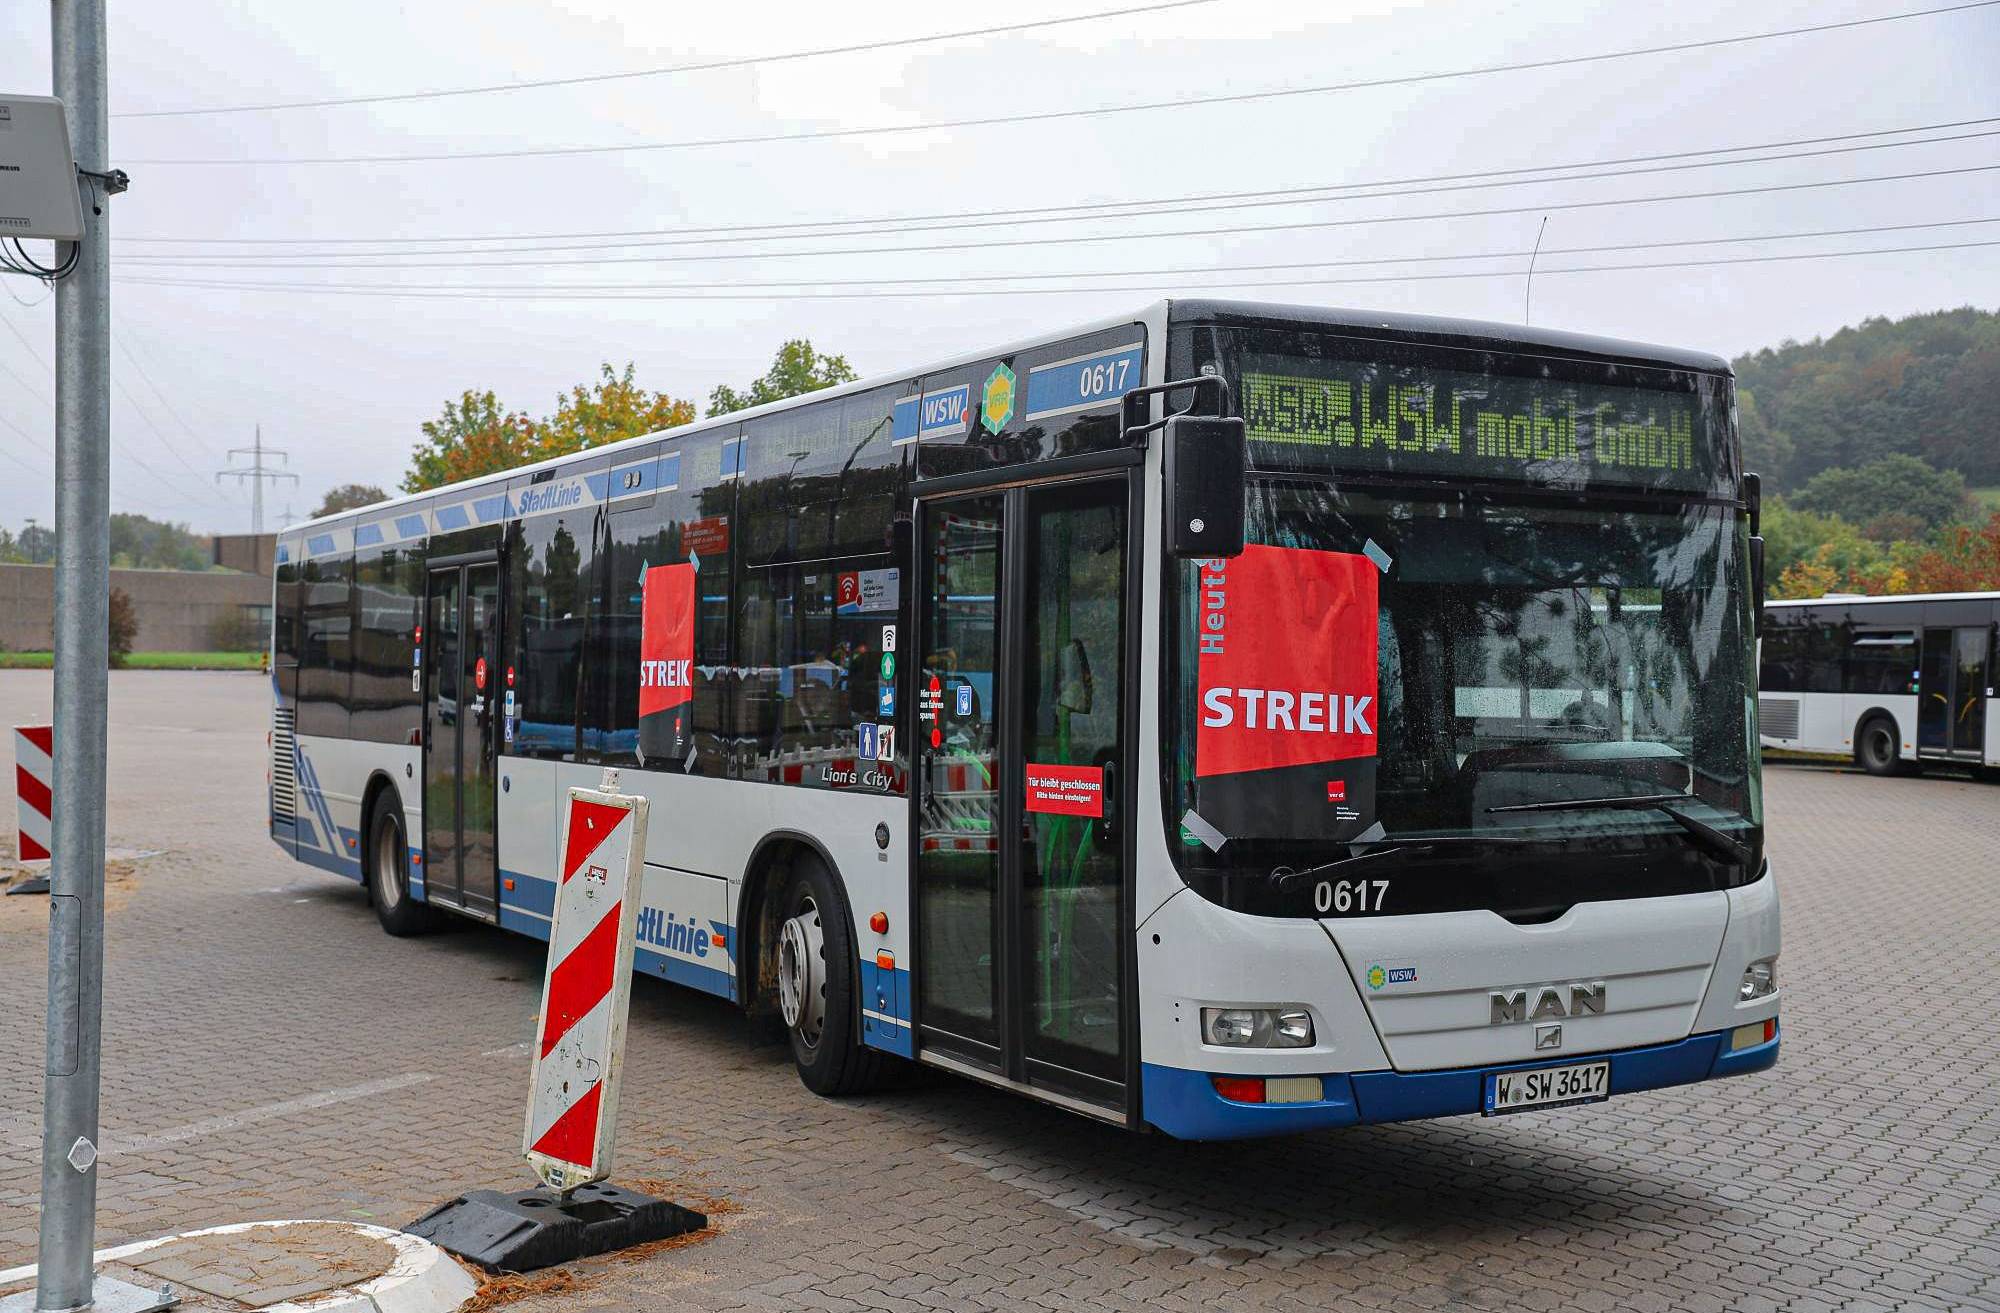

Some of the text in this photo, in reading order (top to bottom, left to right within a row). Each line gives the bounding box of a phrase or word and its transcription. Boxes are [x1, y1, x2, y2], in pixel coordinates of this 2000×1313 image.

[1080, 359, 1130, 397] 0617
[925, 393, 962, 425] WSW
[1361, 382, 1692, 470] WSW mobil GmbH
[519, 482, 581, 514] StadtLinie
[1200, 558, 1226, 655] Heute
[640, 660, 691, 687] STREIK
[1203, 687, 1373, 735] STREIK
[821, 767, 892, 792] Lion's City
[1028, 777, 1100, 791] Tür bleibt geschlossen
[1314, 880, 1389, 913] 0617
[636, 906, 709, 957] dtLinie
[1390, 970, 1413, 981] WSW
[1489, 981, 1606, 1024] MAN
[1498, 1065, 1607, 1104] W SW 3617
